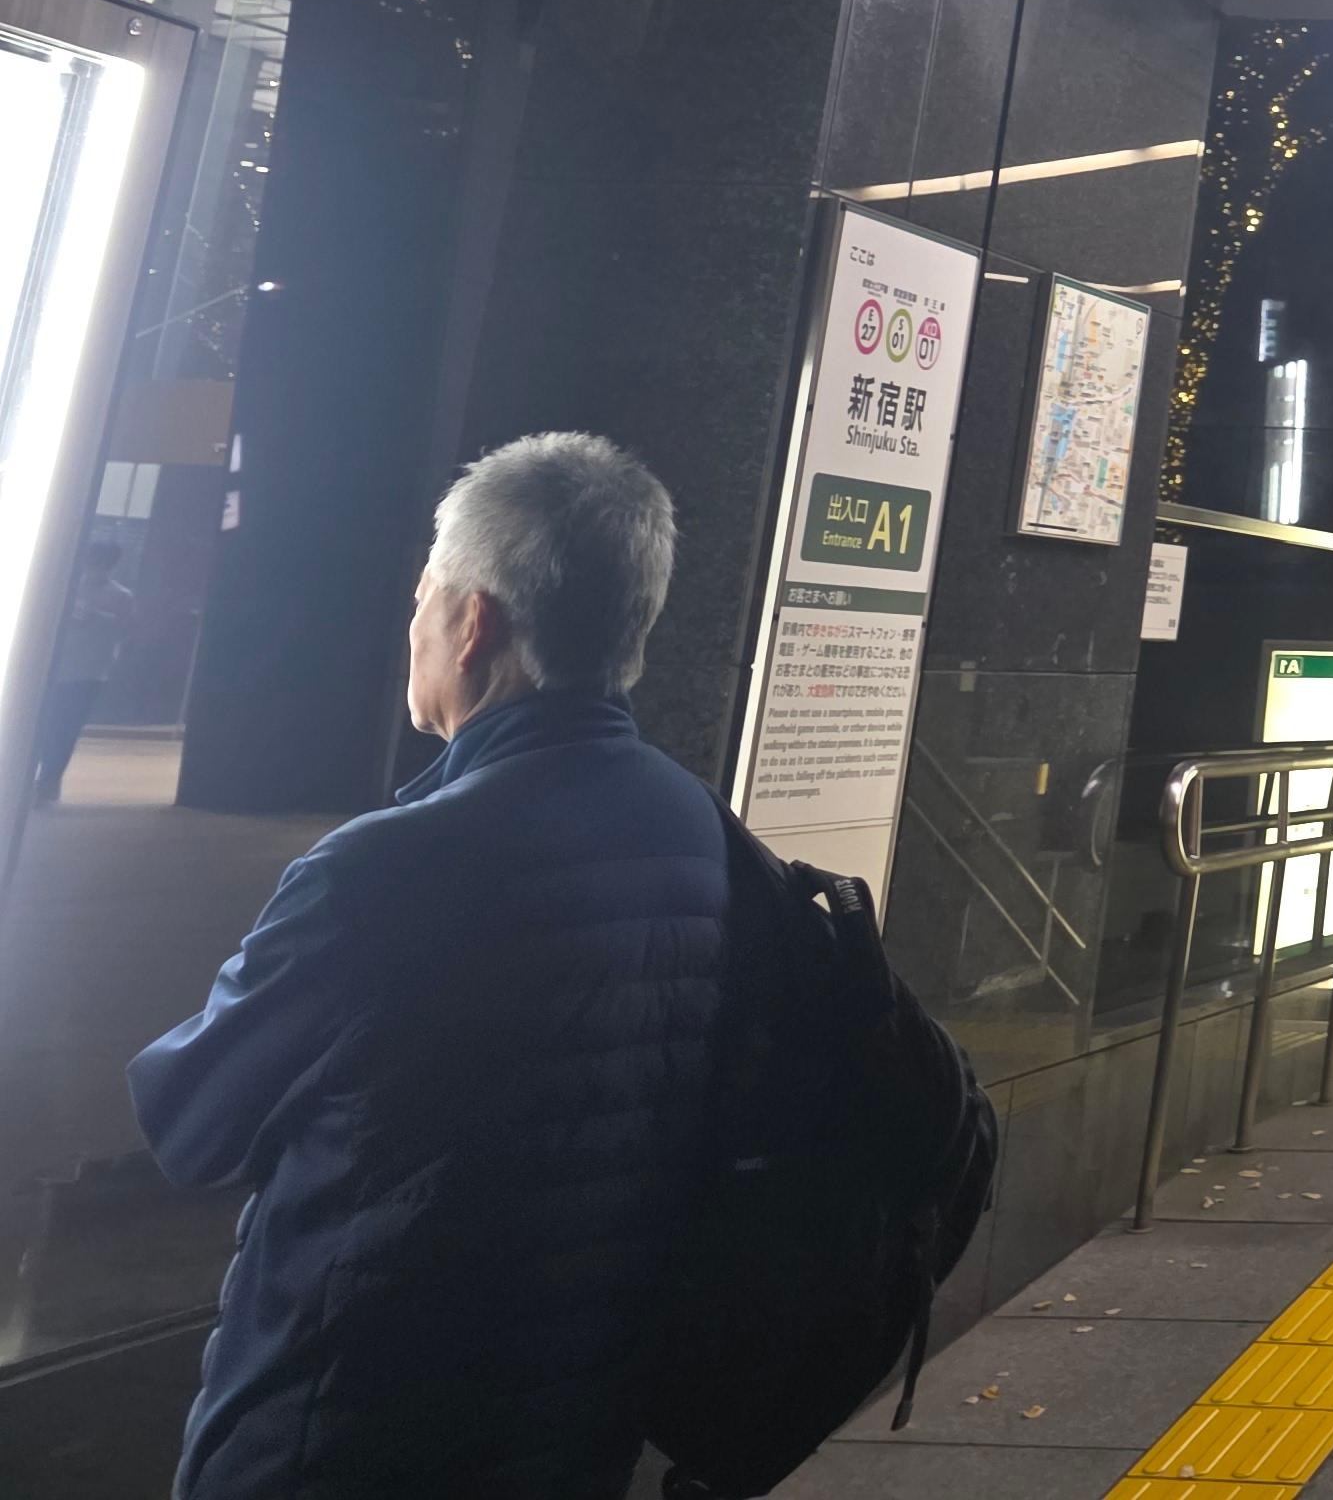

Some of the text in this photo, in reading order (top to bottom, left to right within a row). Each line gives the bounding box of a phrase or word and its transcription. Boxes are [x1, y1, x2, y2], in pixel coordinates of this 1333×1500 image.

[849, 246, 876, 267] ここは
[867, 309, 875, 322] E
[898, 318, 905, 331] S
[860, 323, 877, 342] 27
[891, 331, 905, 351] 01
[918, 337, 936, 362] 01
[847, 372, 928, 434] 新宿駅
[845, 424, 920, 458] Shinjuku Sta.
[826, 492, 870, 525] 出入口
[867, 500, 914, 555] A1
[821, 529, 864, 550] Entrance
